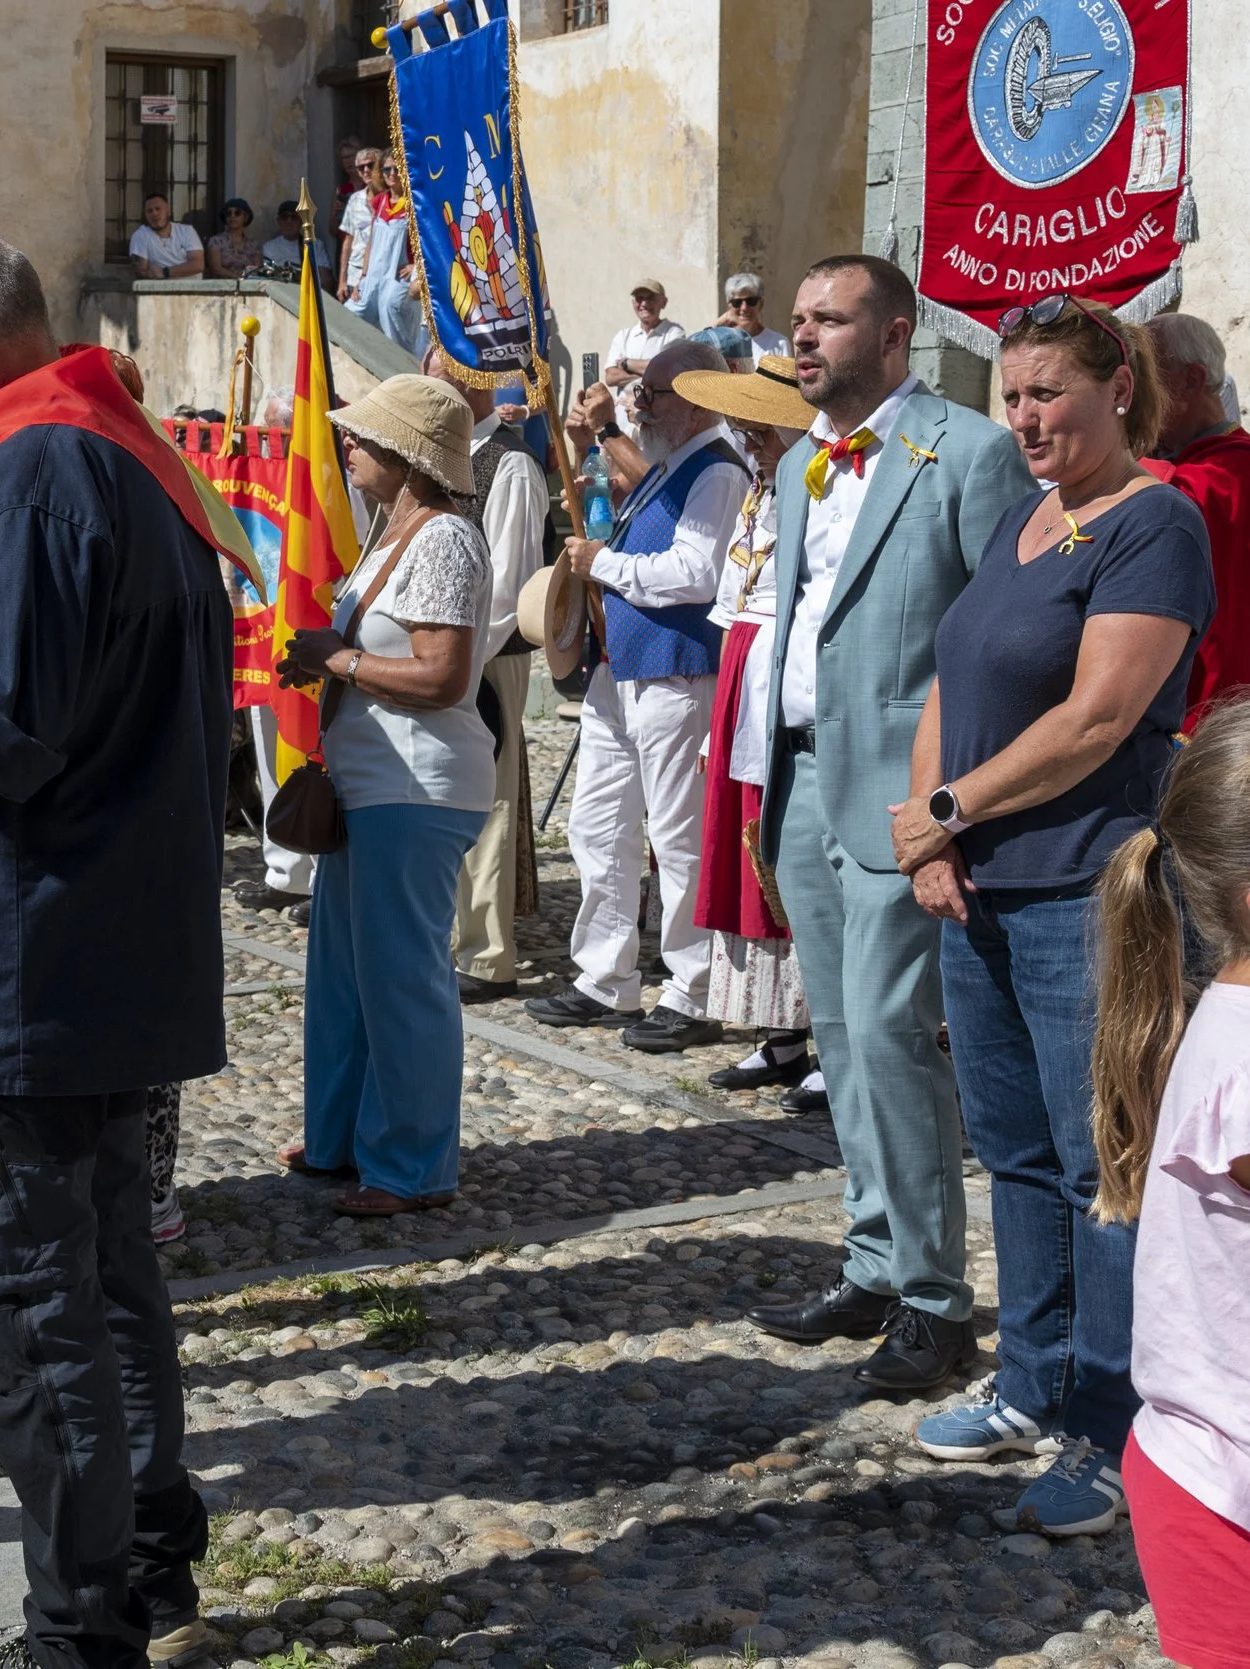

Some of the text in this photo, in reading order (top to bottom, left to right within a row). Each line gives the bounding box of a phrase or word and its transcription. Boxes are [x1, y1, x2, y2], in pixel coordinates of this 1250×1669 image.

[936, 0, 974, 46] SO
[974, 186, 1127, 247] CARAGLIO
[943, 212, 1165, 292] ANNO DI FONDAZIONE
[212, 478, 289, 517] ROUVENÇA
[234, 668, 270, 685] ERES
